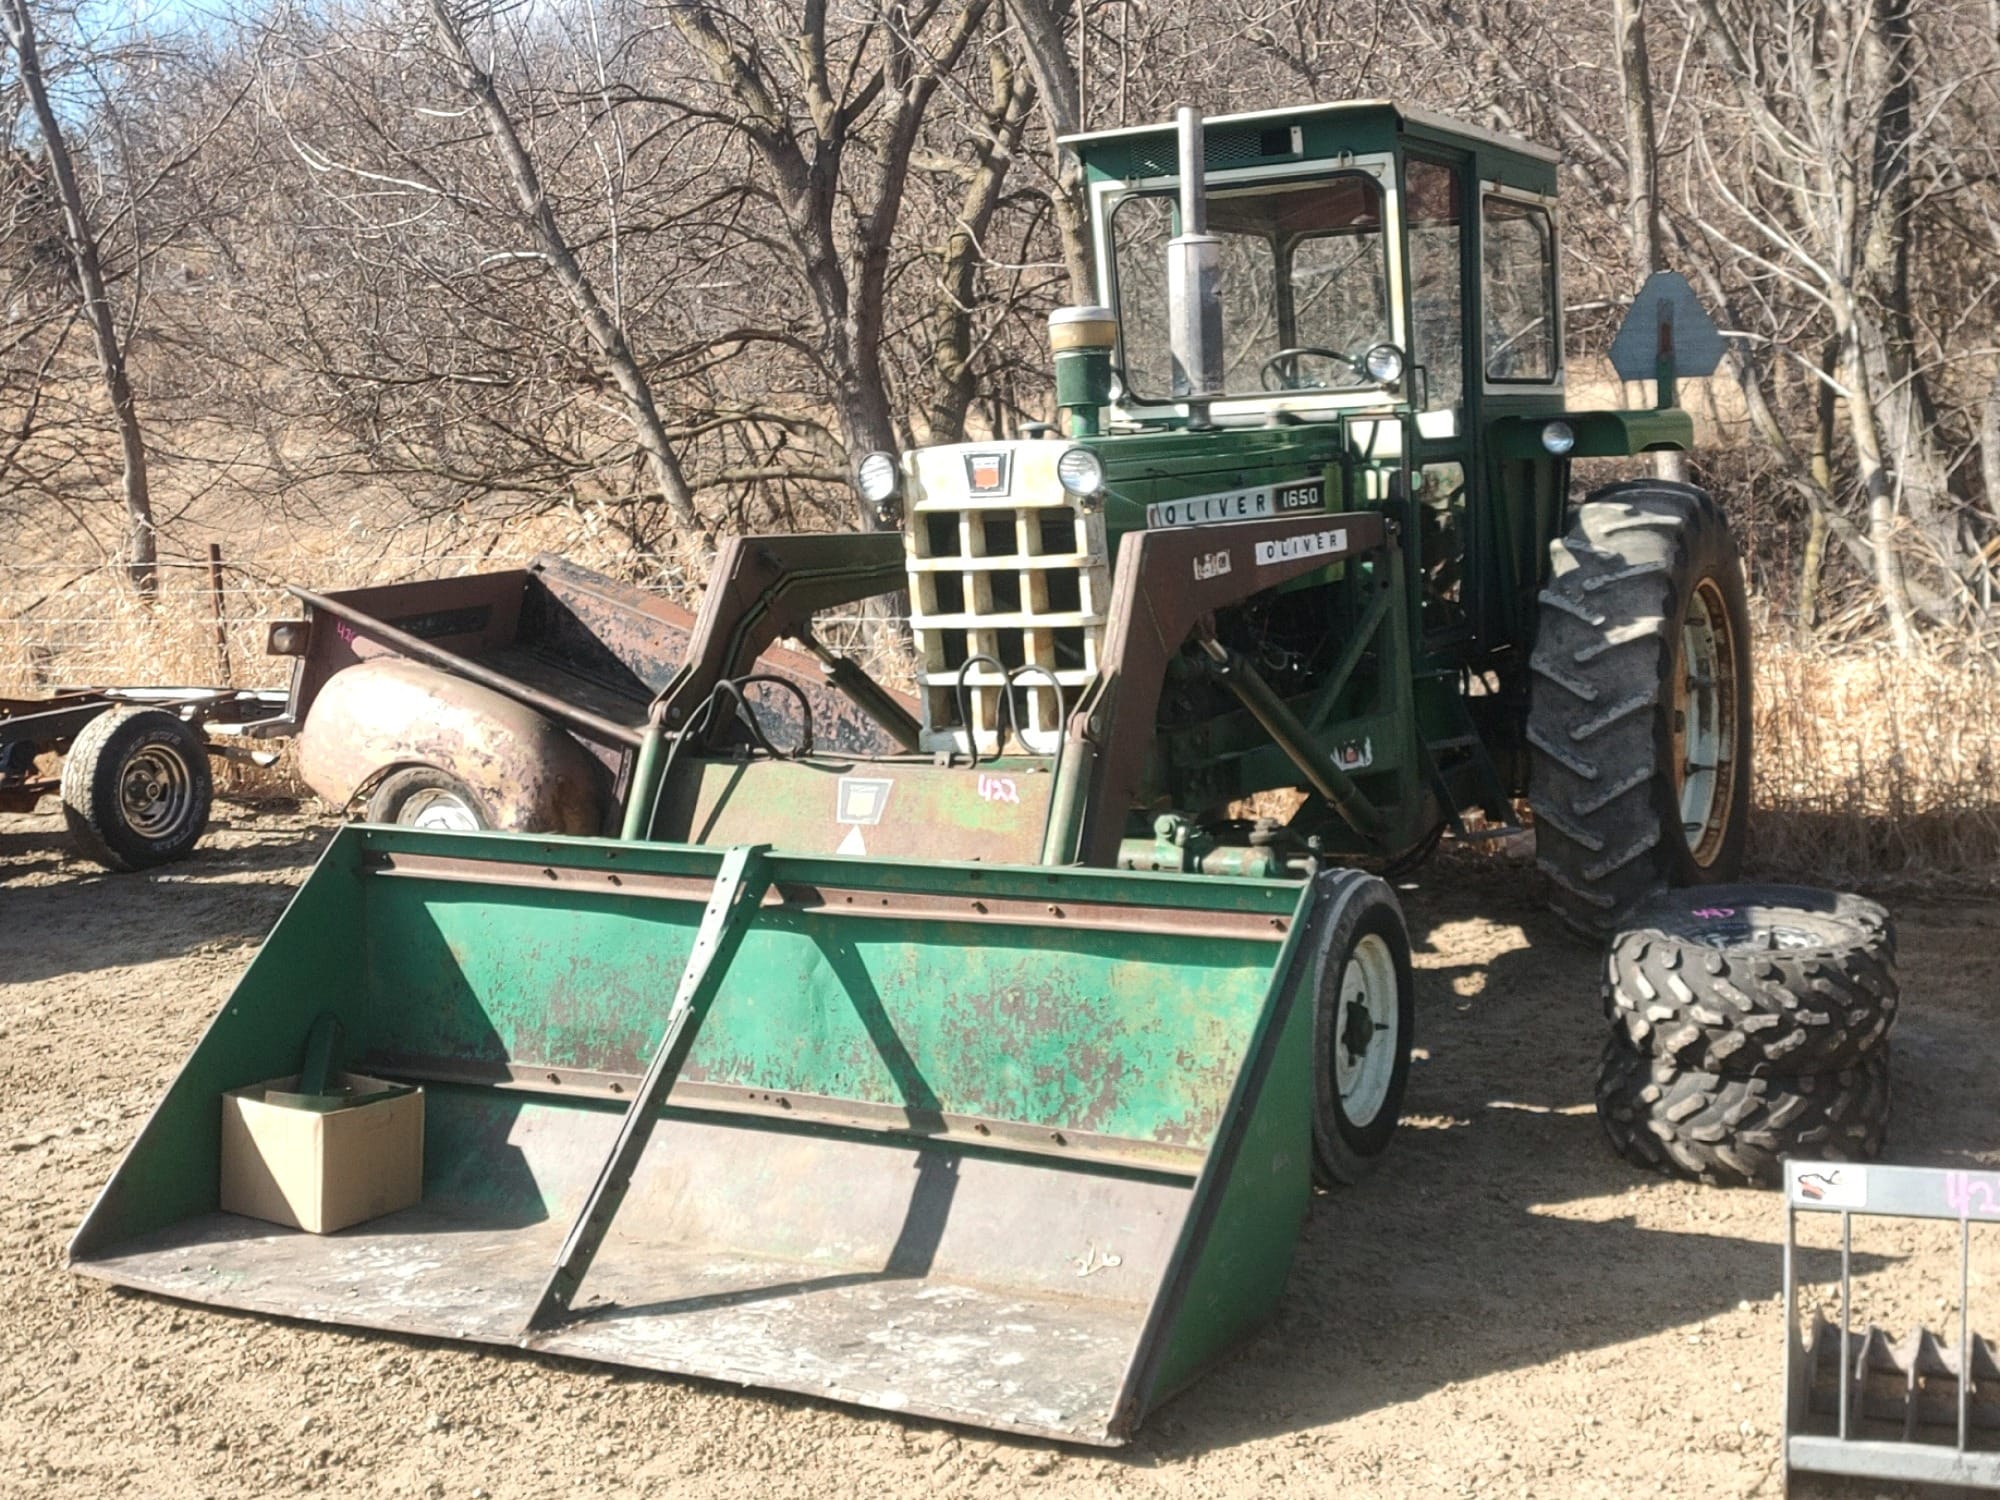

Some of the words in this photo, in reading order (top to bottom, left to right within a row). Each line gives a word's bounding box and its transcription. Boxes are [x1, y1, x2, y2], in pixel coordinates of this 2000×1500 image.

[1165, 494, 1265, 524] OLIVER
[1282, 487, 1319, 508] 1650
[1266, 533, 1337, 559] OLIVER
[1946, 1171, 2000, 1217] 42
